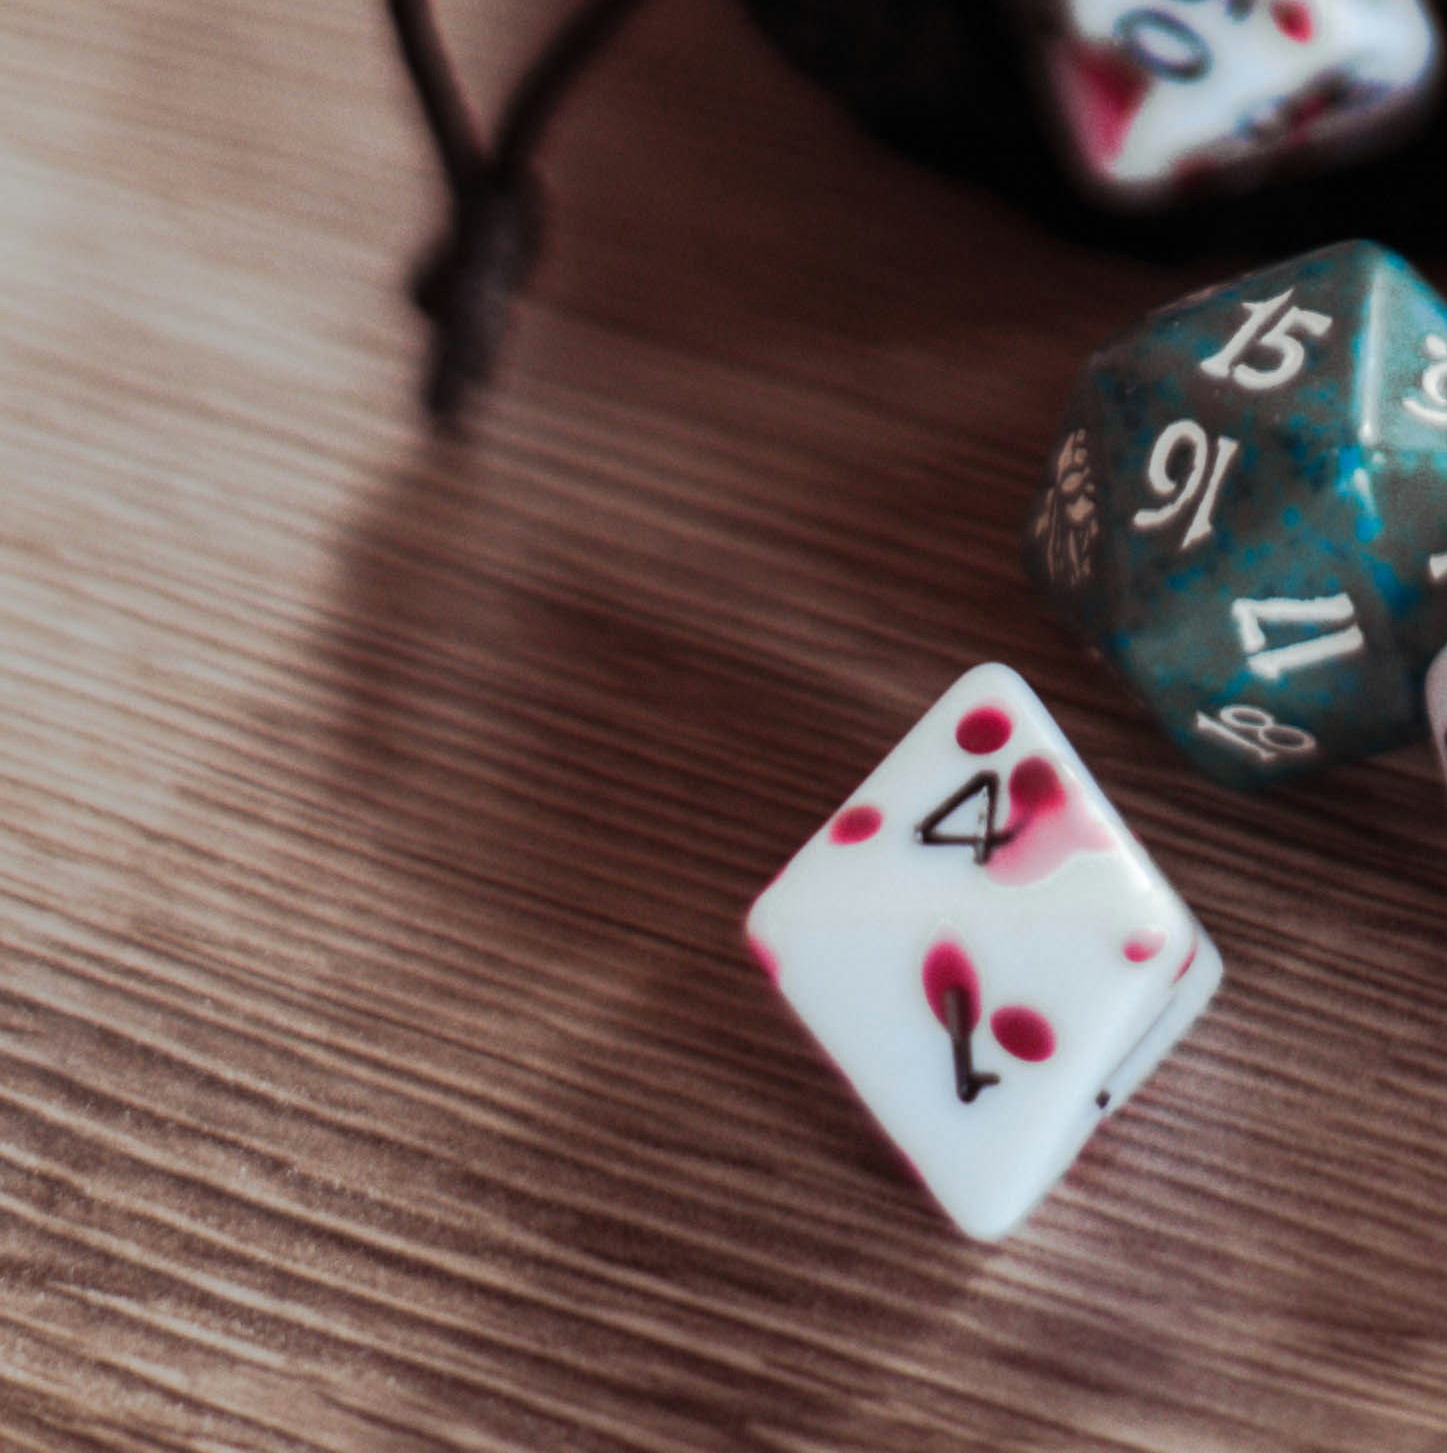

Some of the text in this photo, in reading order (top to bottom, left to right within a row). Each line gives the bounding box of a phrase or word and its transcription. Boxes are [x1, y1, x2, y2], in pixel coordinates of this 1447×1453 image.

[1200, 289, 1332, 390] 15
[1133, 419, 1238, 549] 16
[1232, 593, 1363, 680] 17
[1196, 703, 1316, 761] 18
[915, 771, 1031, 865] 4
